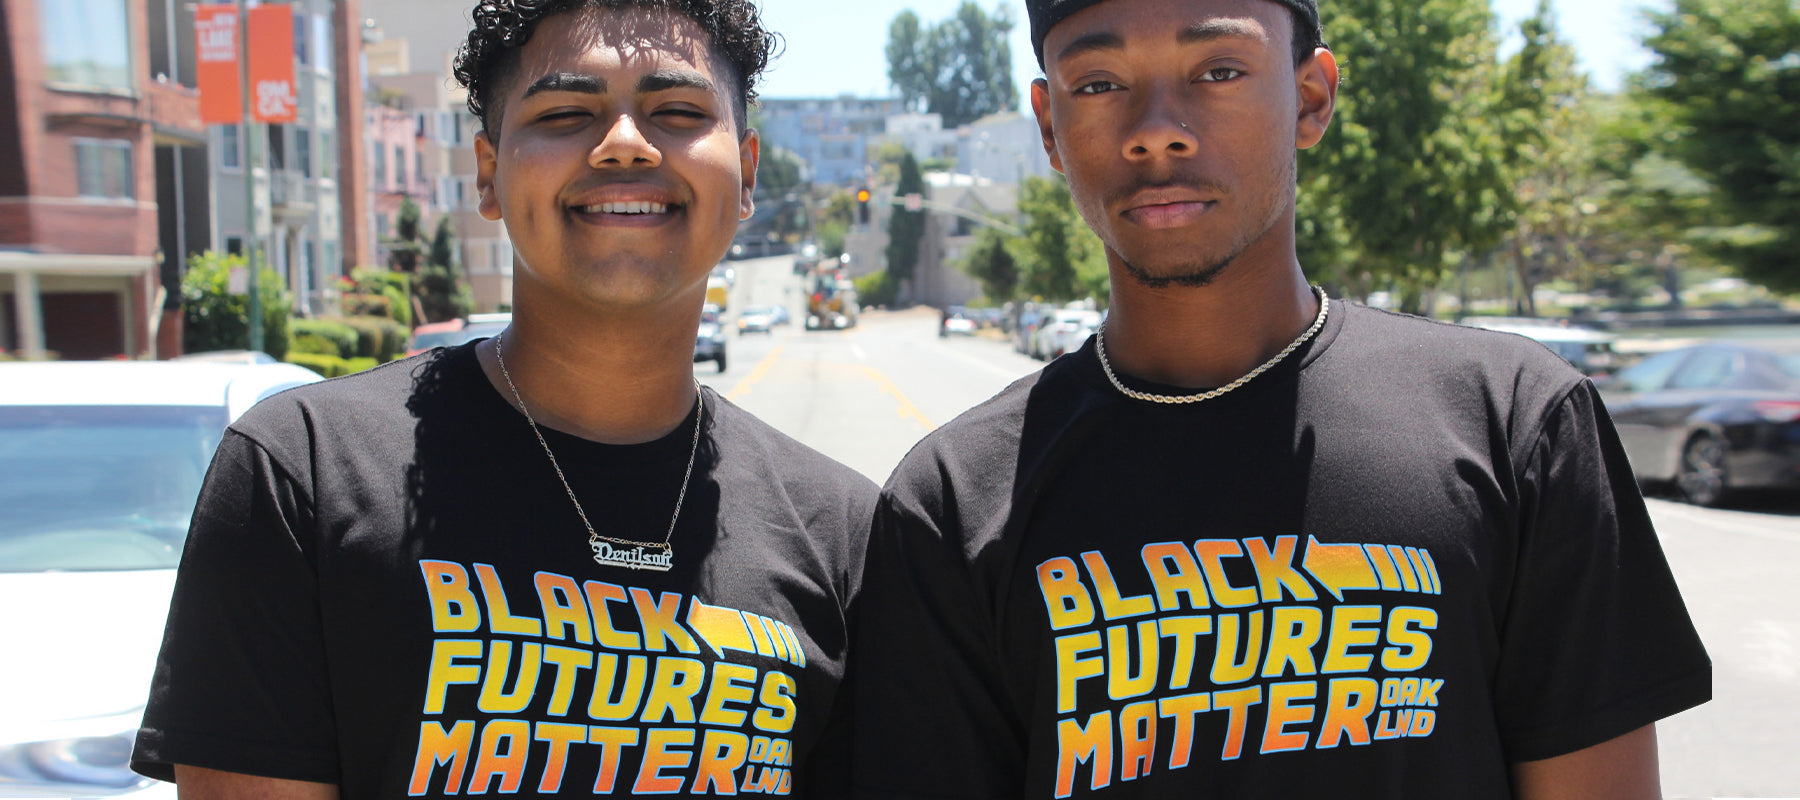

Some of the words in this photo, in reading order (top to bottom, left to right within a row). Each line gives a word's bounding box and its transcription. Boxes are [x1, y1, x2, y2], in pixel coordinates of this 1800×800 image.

[591, 541, 673, 568] Denilson
[1036, 535, 1318, 630] BLACK
[419, 559, 700, 654] BLACK
[423, 639, 797, 733] FUTURES
[1055, 605, 1438, 713] FUTURES
[1380, 677, 1445, 707] OAK
[408, 719, 749, 796] MATTER
[748, 735, 792, 767] OA
[1054, 678, 1379, 799] MATTER
[1374, 708, 1436, 740] LND
[740, 765, 792, 795] LND
